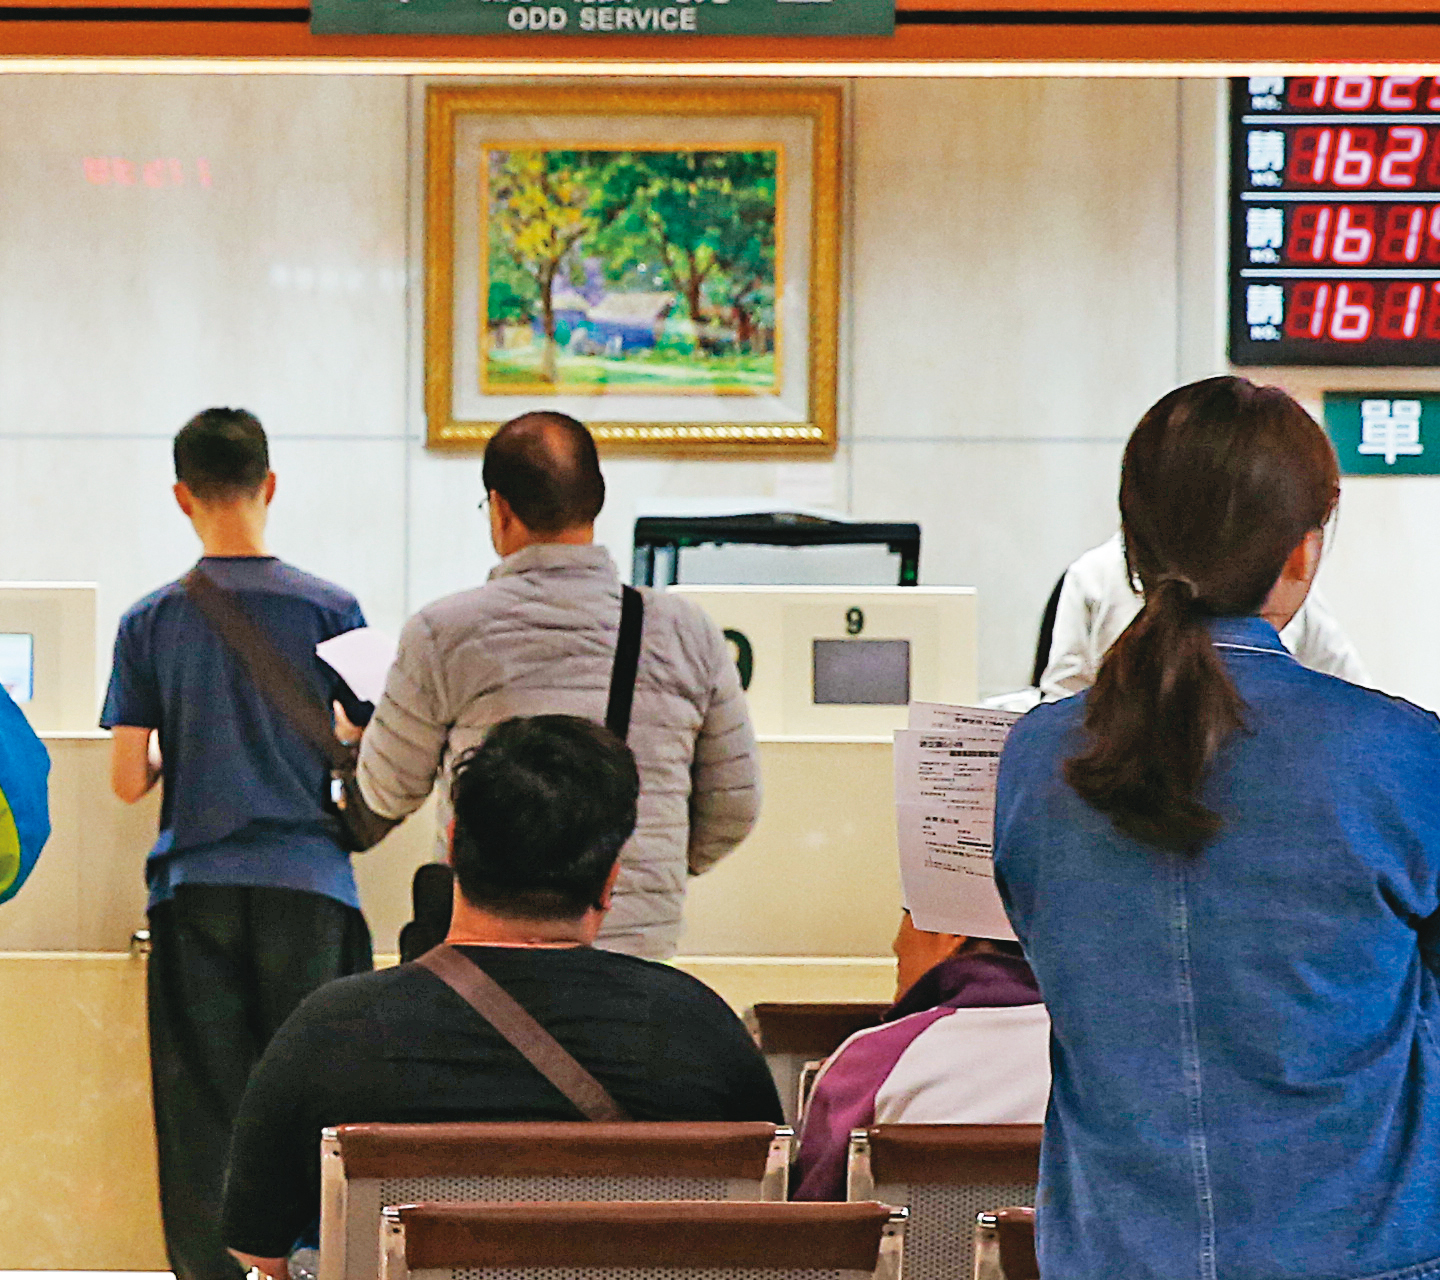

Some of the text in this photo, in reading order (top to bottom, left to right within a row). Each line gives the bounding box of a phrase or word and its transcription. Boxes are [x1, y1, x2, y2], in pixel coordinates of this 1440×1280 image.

[508, 7, 696, 31] ODD SERVICE
[846, 607, 864, 634] 9
